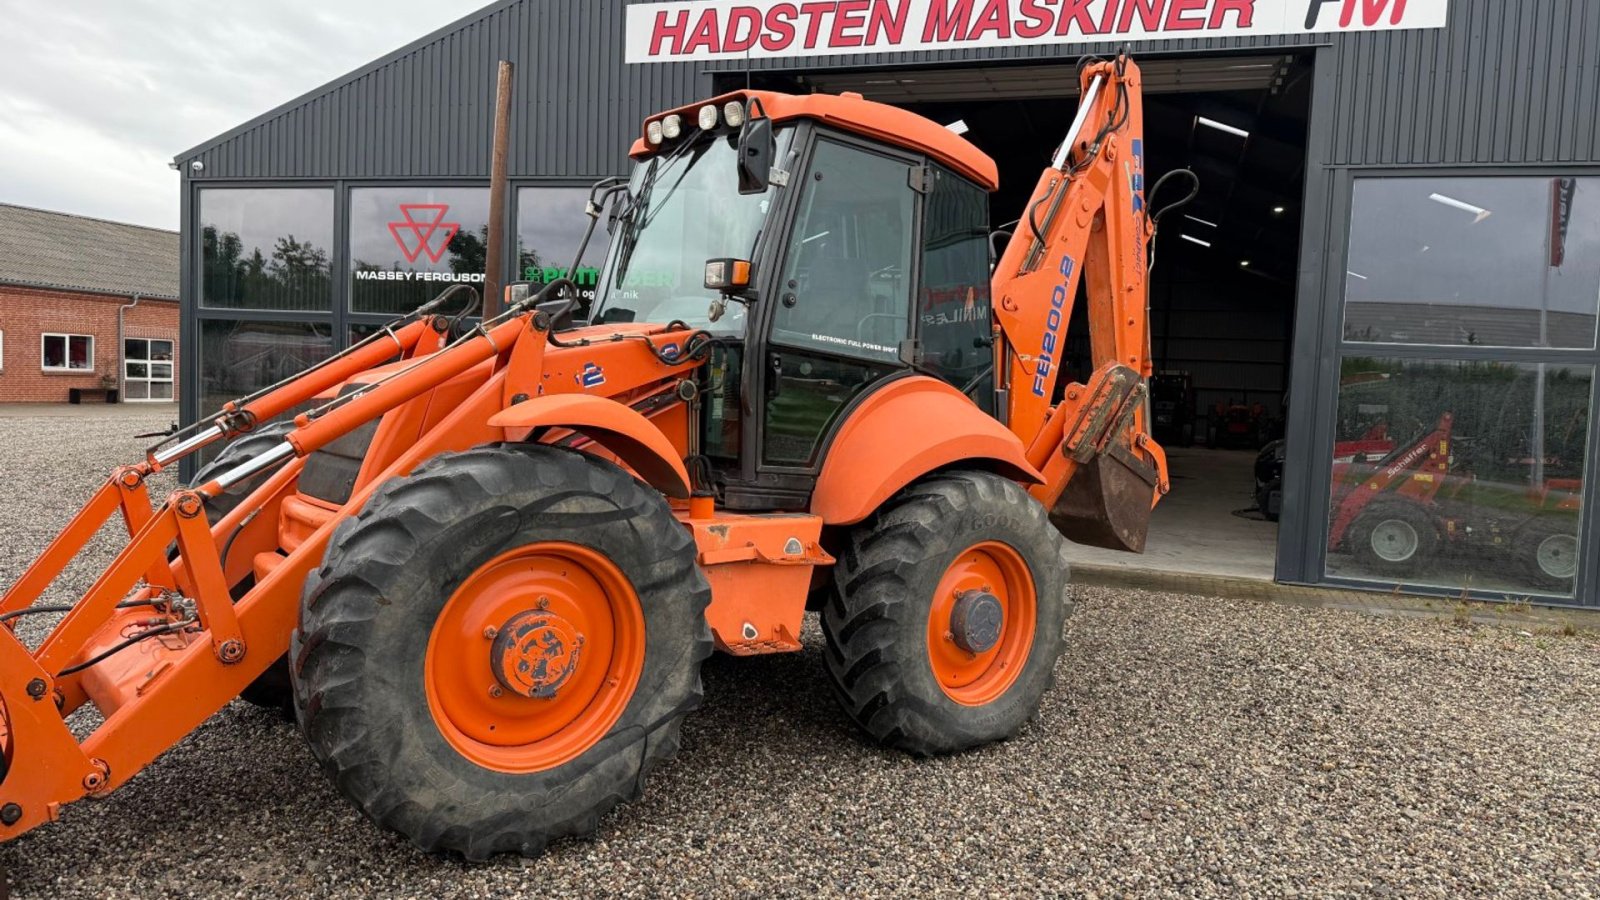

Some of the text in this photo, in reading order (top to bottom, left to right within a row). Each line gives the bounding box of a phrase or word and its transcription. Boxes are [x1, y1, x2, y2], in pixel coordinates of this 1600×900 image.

[648, 0, 1256, 56] HADSTEN MASKINER
[356, 271, 412, 281] MASSEY
[812, 333, 898, 354] ELECTRONIC FULL POWER SHIFT
[1032, 255, 1075, 397] FB200.2
